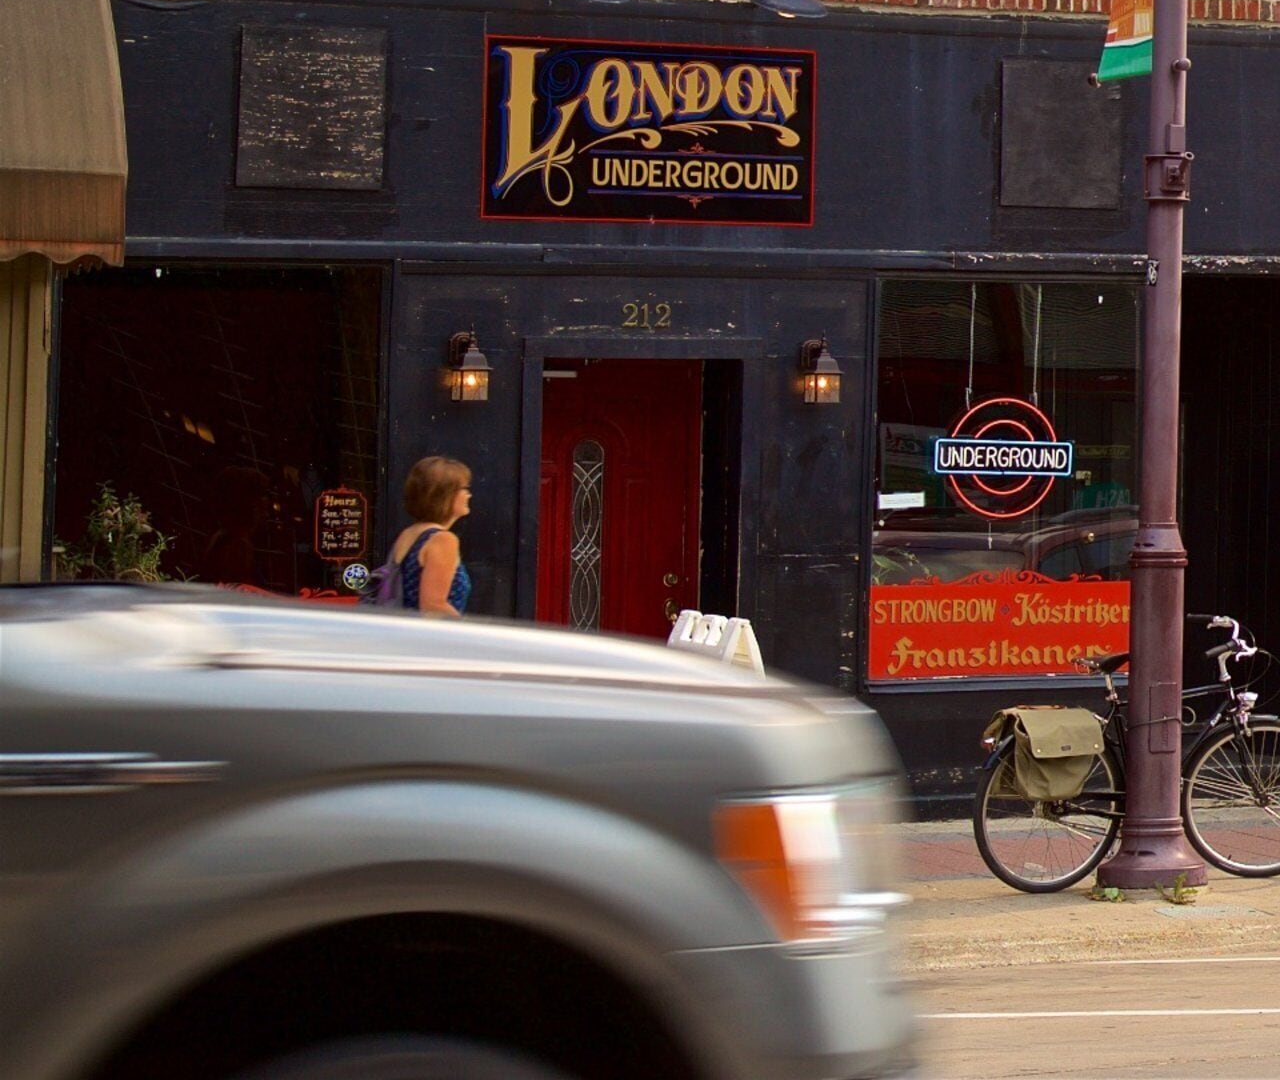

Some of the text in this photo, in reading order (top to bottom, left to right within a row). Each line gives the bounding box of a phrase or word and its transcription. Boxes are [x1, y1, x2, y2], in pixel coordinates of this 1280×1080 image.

[498, 47, 803, 206] LONDON
[592, 157, 798, 191] UNDERGROUND
[622, 303, 672, 329] 212
[939, 446, 1068, 469] UNDERGROUND
[874, 599, 997, 625] STRONGBOW
